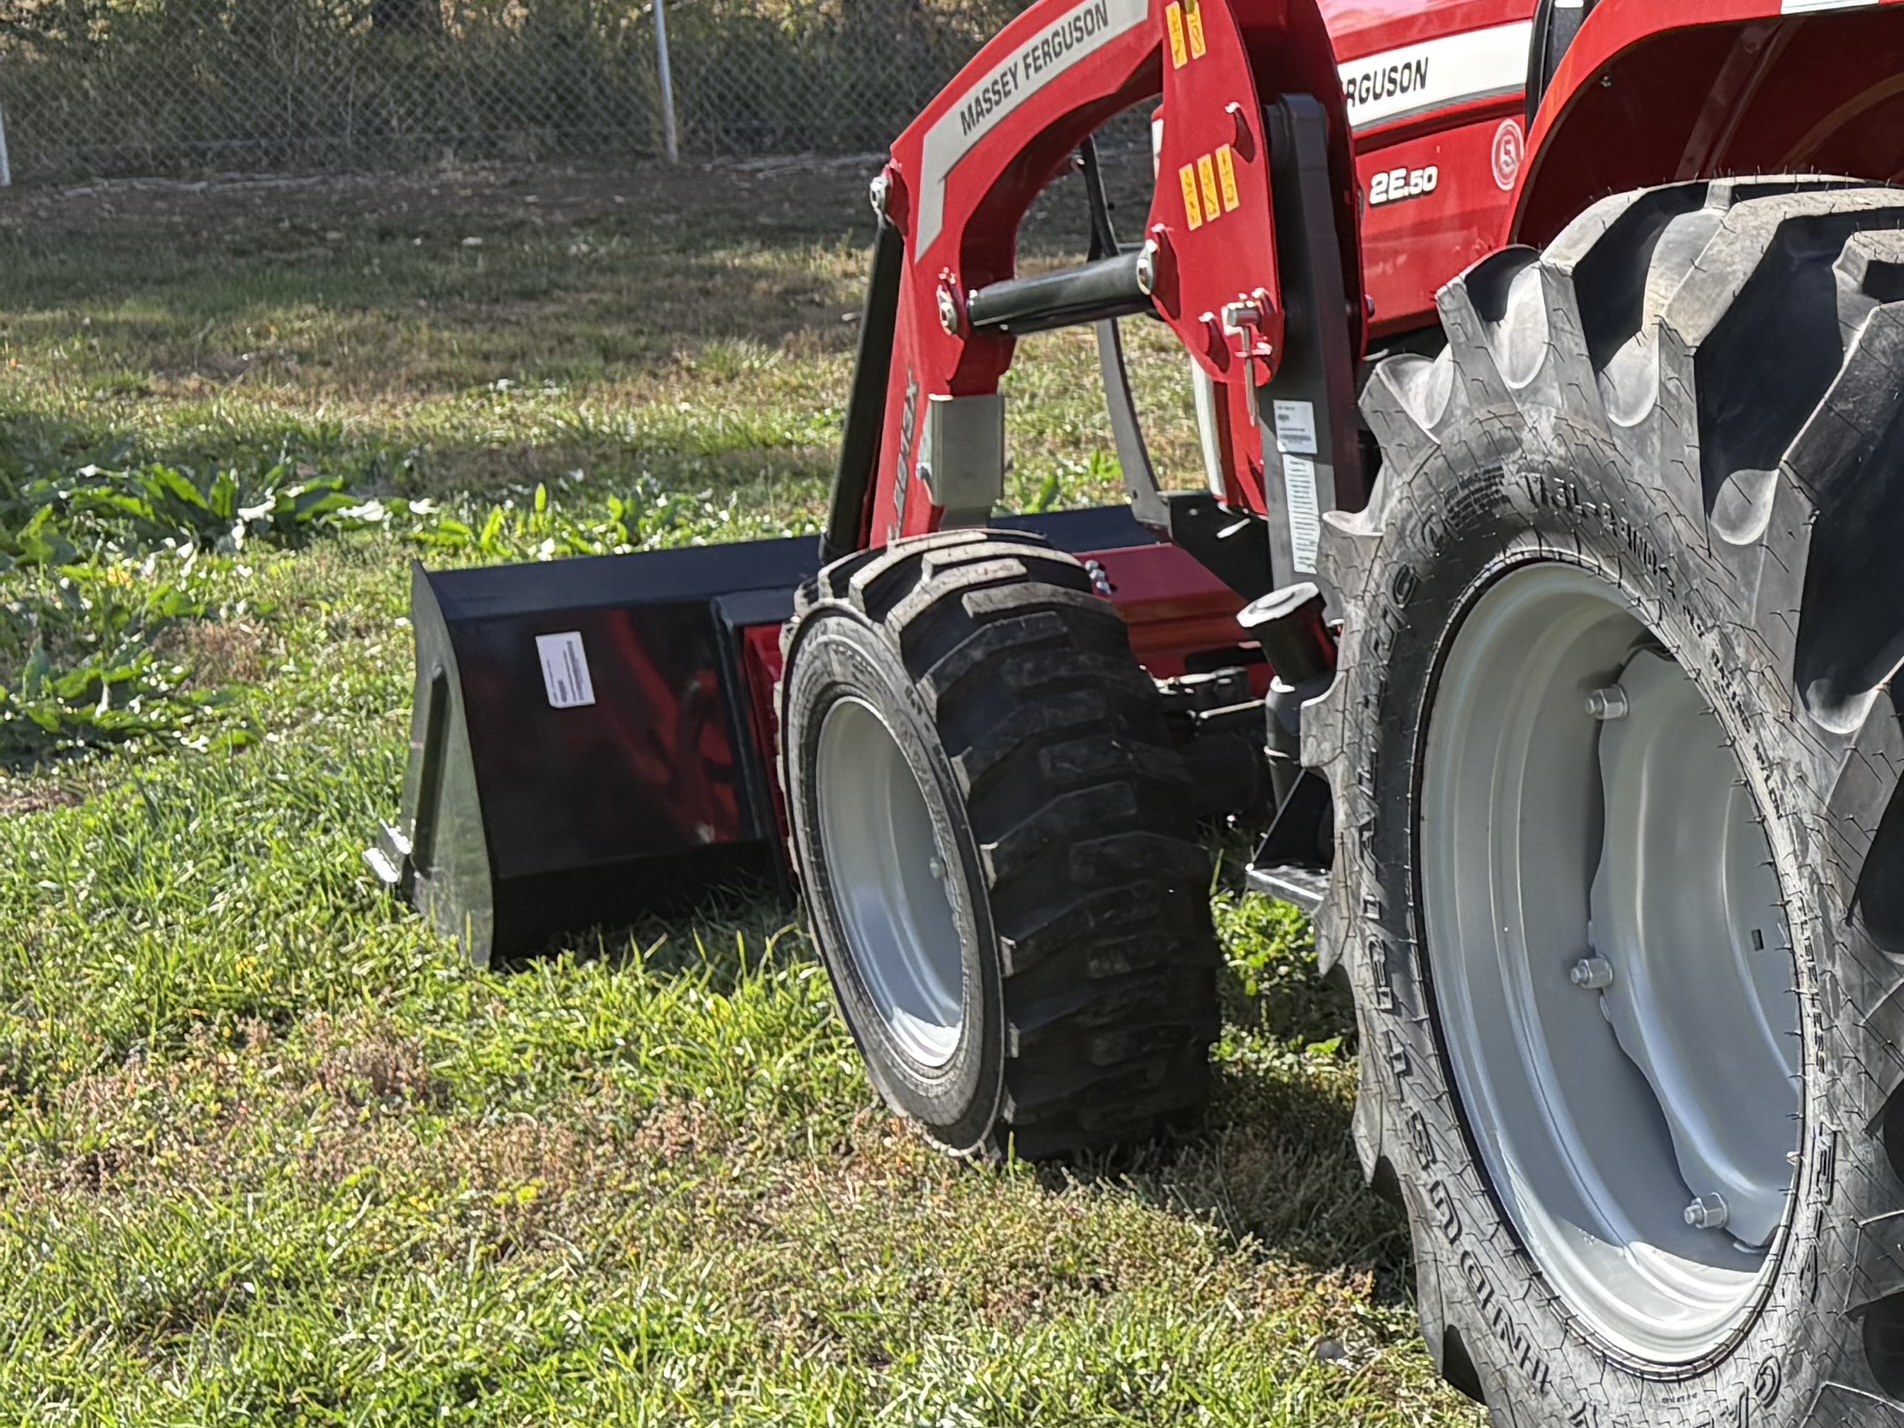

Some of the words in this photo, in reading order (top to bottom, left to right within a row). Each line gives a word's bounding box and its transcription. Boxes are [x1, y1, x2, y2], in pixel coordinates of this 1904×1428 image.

[960, 61, 1018, 136] MASSEY
[1022, 0, 1109, 81] FERGUSON
[1369, 165, 1438, 205] 2E.50
